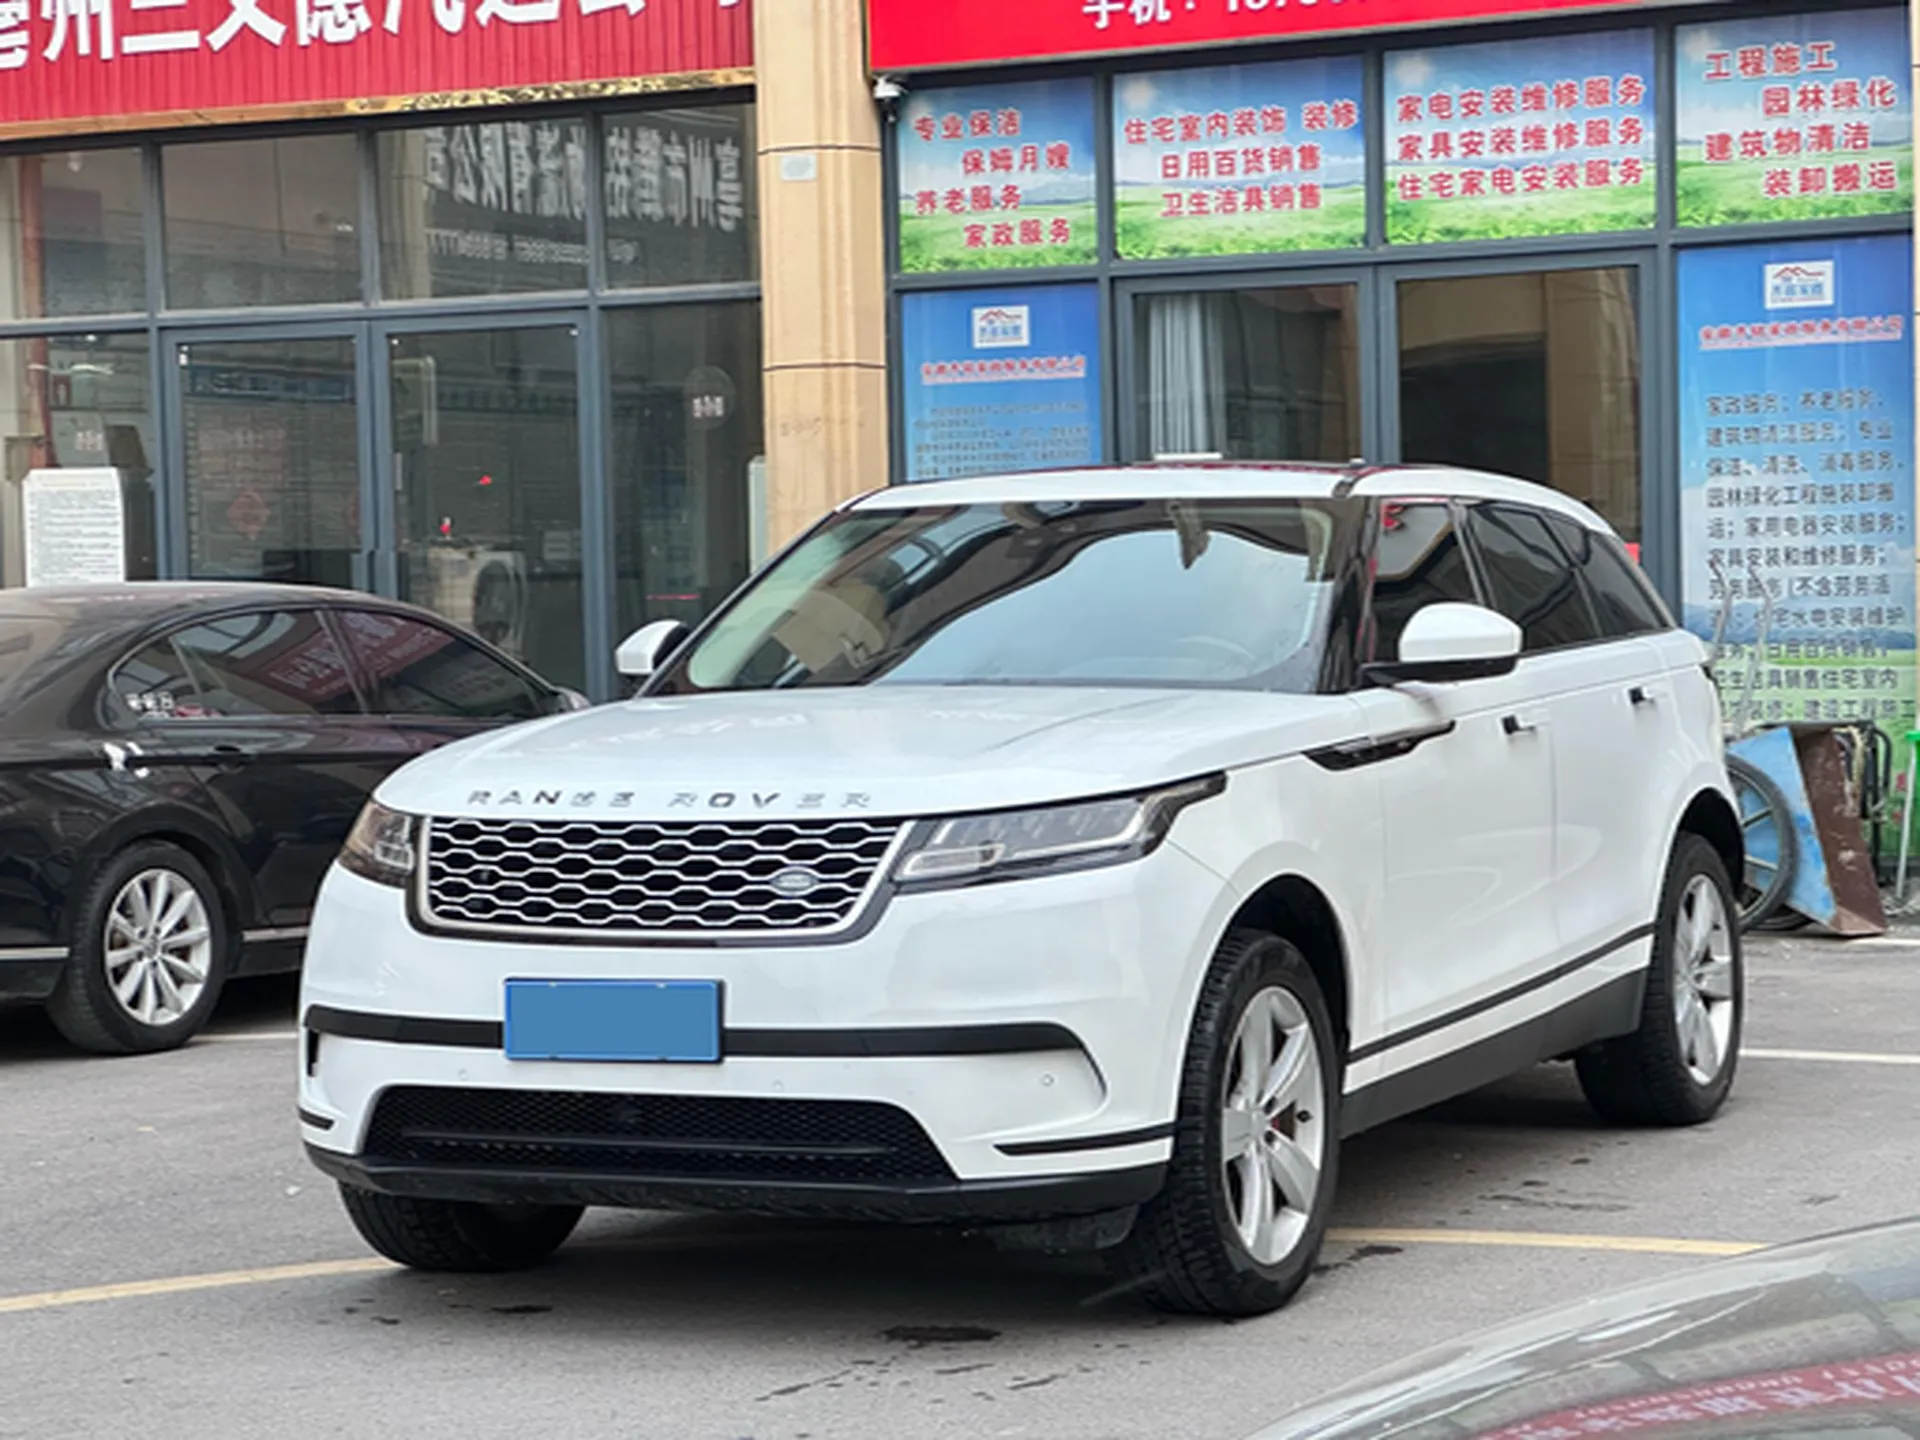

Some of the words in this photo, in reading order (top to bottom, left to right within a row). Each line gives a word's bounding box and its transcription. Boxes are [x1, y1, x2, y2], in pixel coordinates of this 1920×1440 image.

[1705, 41, 1837, 80] 工程施工
[1397, 74, 1646, 123] 家电安装维修服务
[1762, 79, 1897, 118] 园林绿化
[914, 109, 1021, 141] 专业保洁
[1124, 107, 1287, 145] 住宅室内装饰
[1303, 99, 1359, 130] 装修
[1397, 117, 1645, 162] 家具安装维修服务
[962, 142, 1070, 175] 保姆月嫂
[1160, 143, 1321, 179] 日用百货销售
[1705, 121, 1872, 164] 建筑物清洁
[1397, 157, 1645, 201] 住宅家电安装服务
[1763, 160, 1897, 198] 装卸搬运
[915, 185, 1022, 215] 养老服务
[1160, 183, 1321, 218] 卫生洁具销售
[963, 218, 1070, 248] 家政服务
[467, 790, 635, 808] RANGE
[667, 792, 871, 809] ROVER
